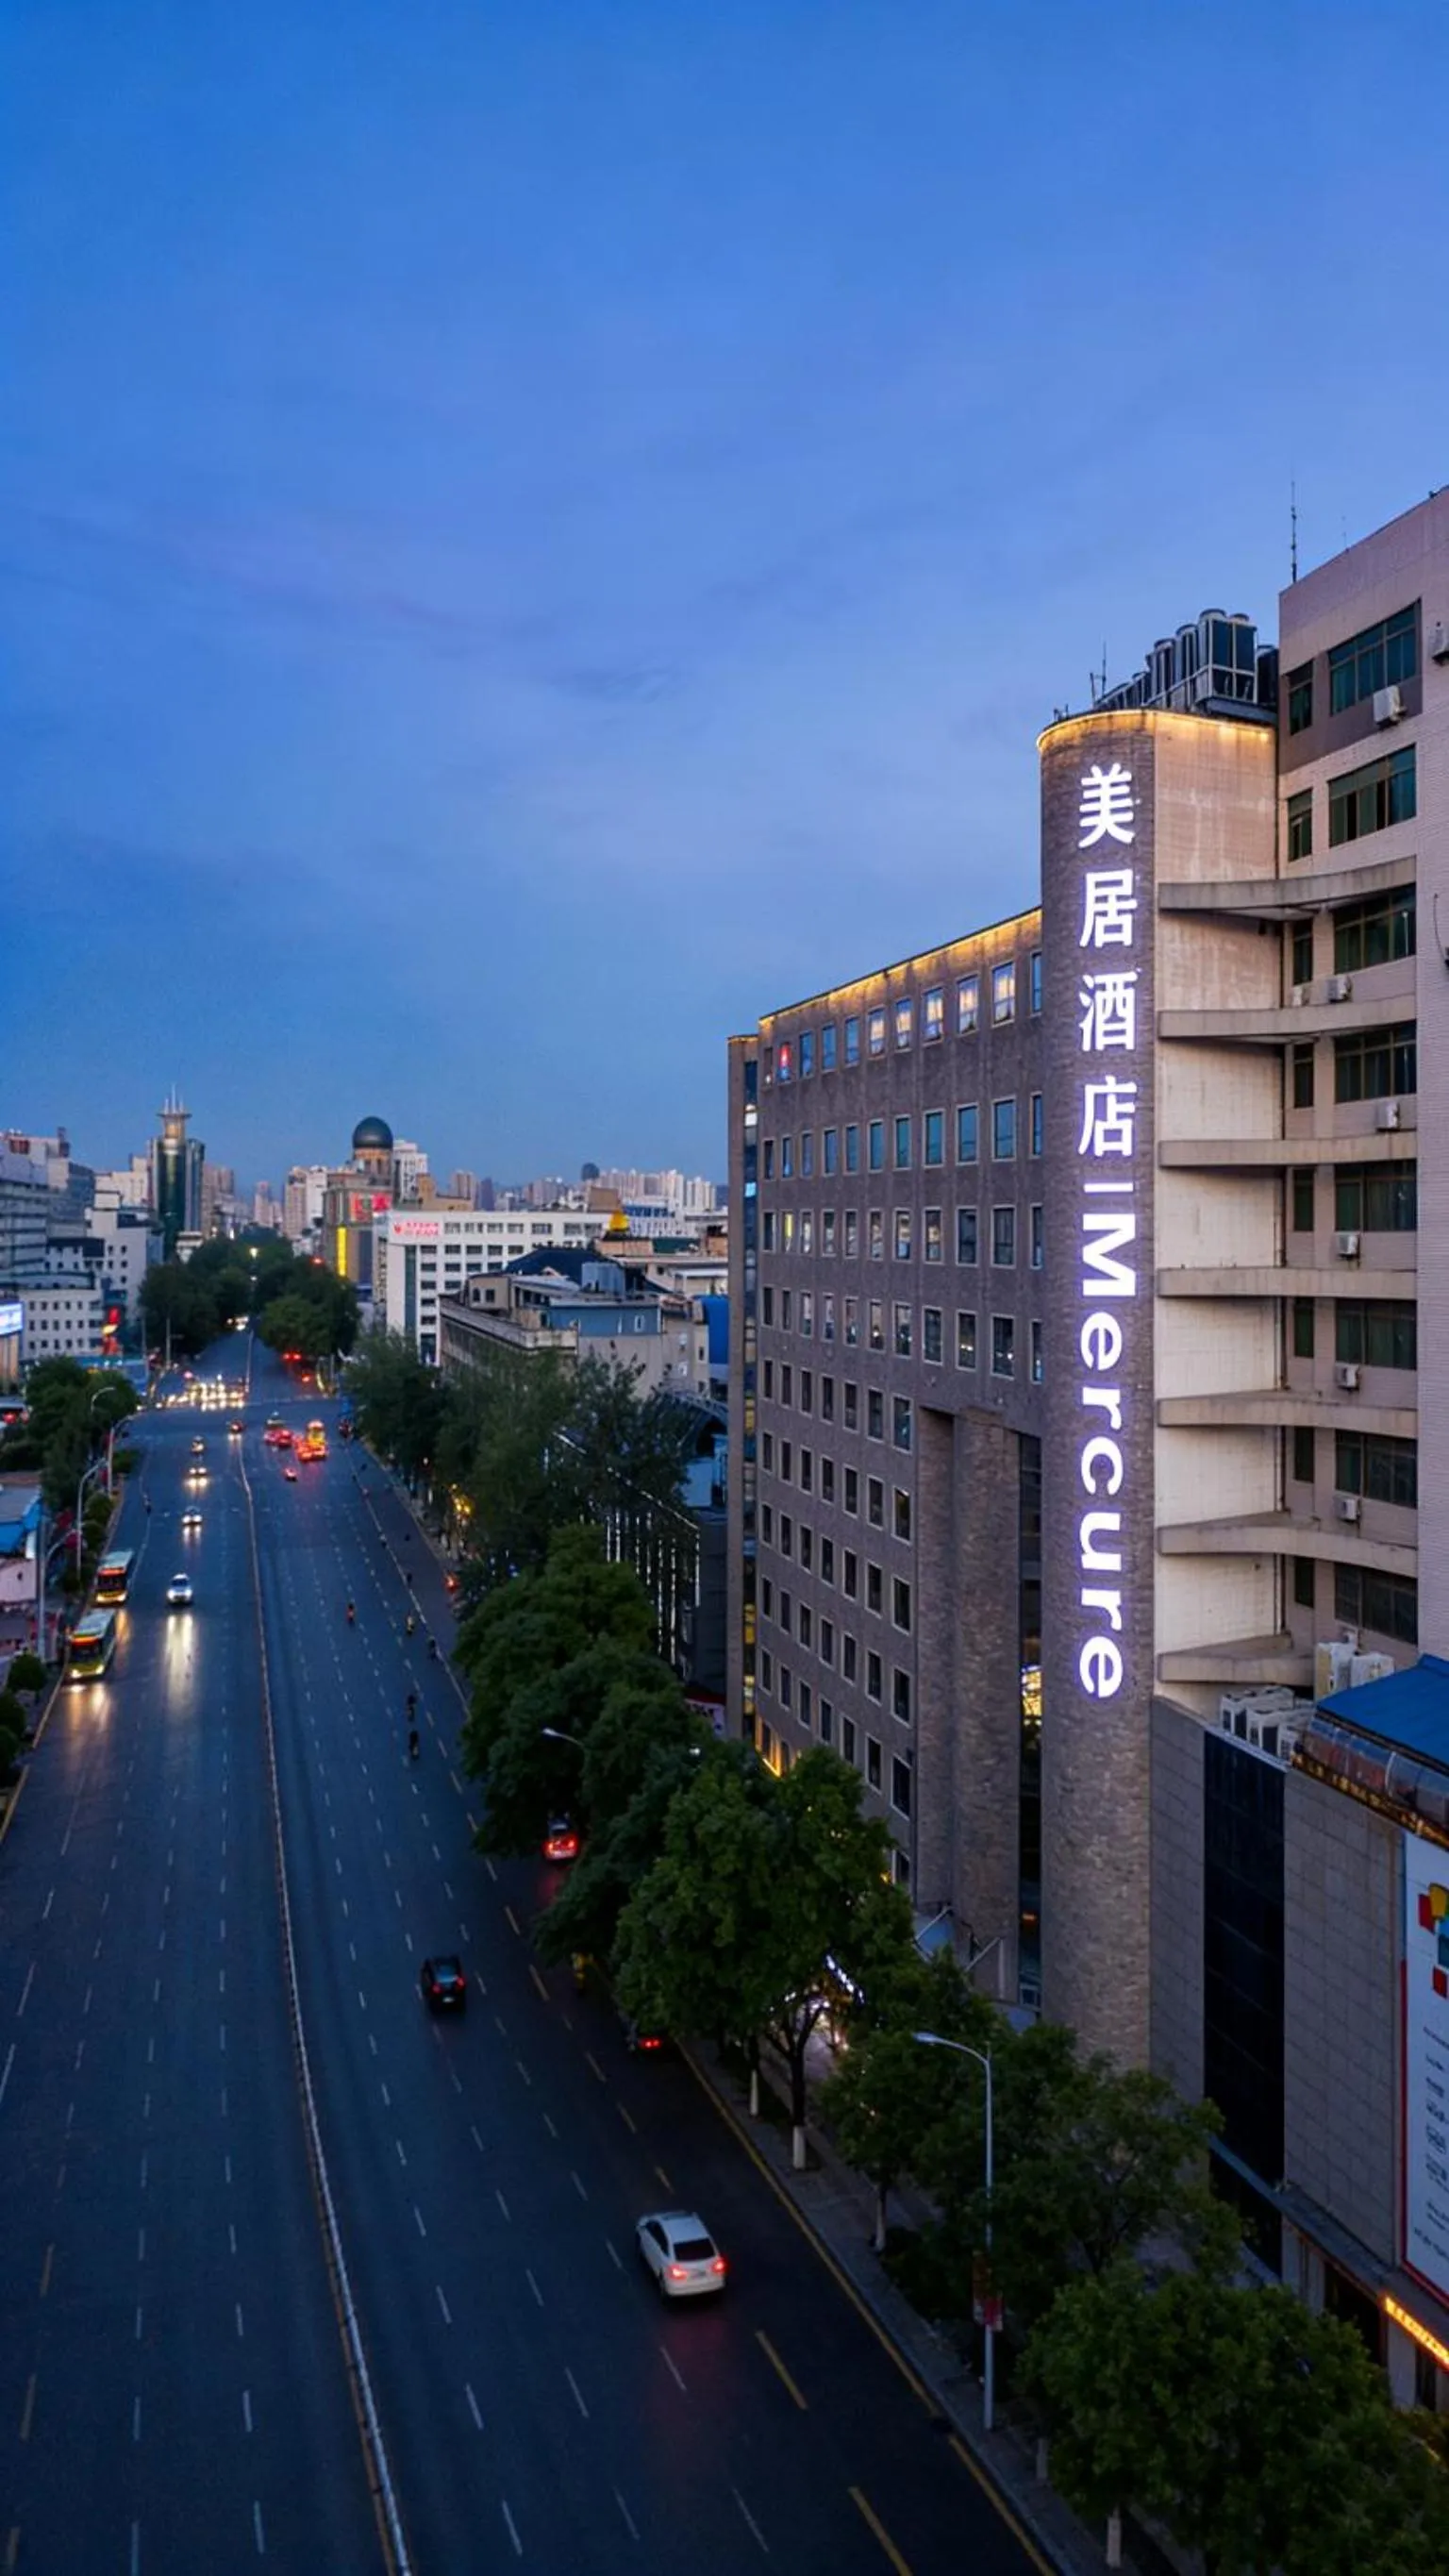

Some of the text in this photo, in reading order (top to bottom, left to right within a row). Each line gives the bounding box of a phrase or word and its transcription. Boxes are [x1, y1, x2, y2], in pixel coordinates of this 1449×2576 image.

[1078, 762, 1140, 1156] 美居酒店
[1079, 1213, 1136, 1698] Mercure
